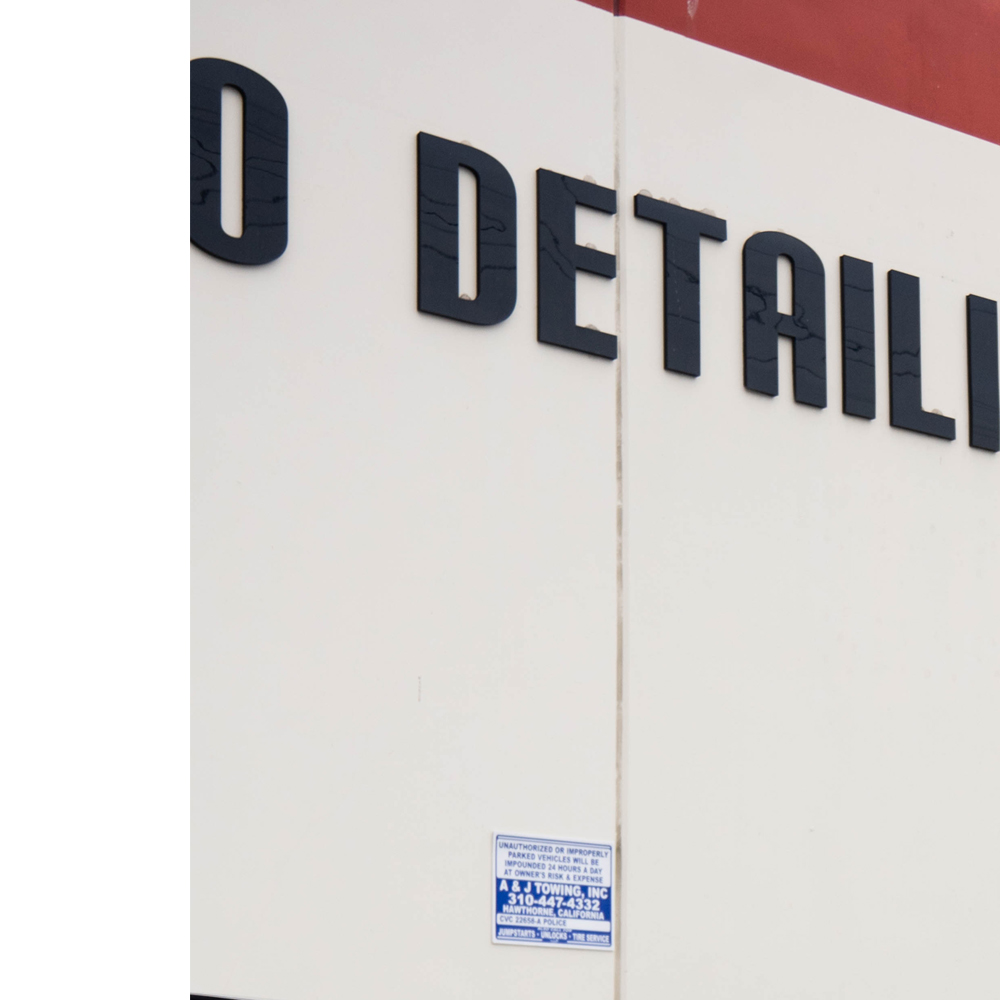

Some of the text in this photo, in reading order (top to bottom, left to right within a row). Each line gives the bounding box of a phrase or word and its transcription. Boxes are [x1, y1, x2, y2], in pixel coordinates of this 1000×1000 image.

[498, 842, 609, 858] UNAUTHORIZED OR IMPROPERLY
[508, 851, 536, 860] PARKED
[538, 854, 571, 864] VEHICLES
[573, 857, 588, 865] WILL
[504, 860, 546, 870] IMPOUNDED
[548, 863, 556, 871] 24
[558, 864, 581, 873] HOURS
[590, 867, 602, 875] DAY
[514, 870, 546, 879] OWNER'S
[548, 872, 564, 880] RISK
[573, 875, 603, 884] EXPENSE
[499, 879, 609, 900] A & J TOWING, INC
[508, 892, 601, 912] 310-447-4332
[500, 915, 513, 923] CVC
[502, 904, 605, 920] HAWTHORNE, CALIFORNIA
[498, 928, 536, 938] JUMPSTARTS
[540, 930, 568, 940] UNLOCKS
[572, 932, 586, 942] TIRE
[586, 934, 610, 943] SERVICE
